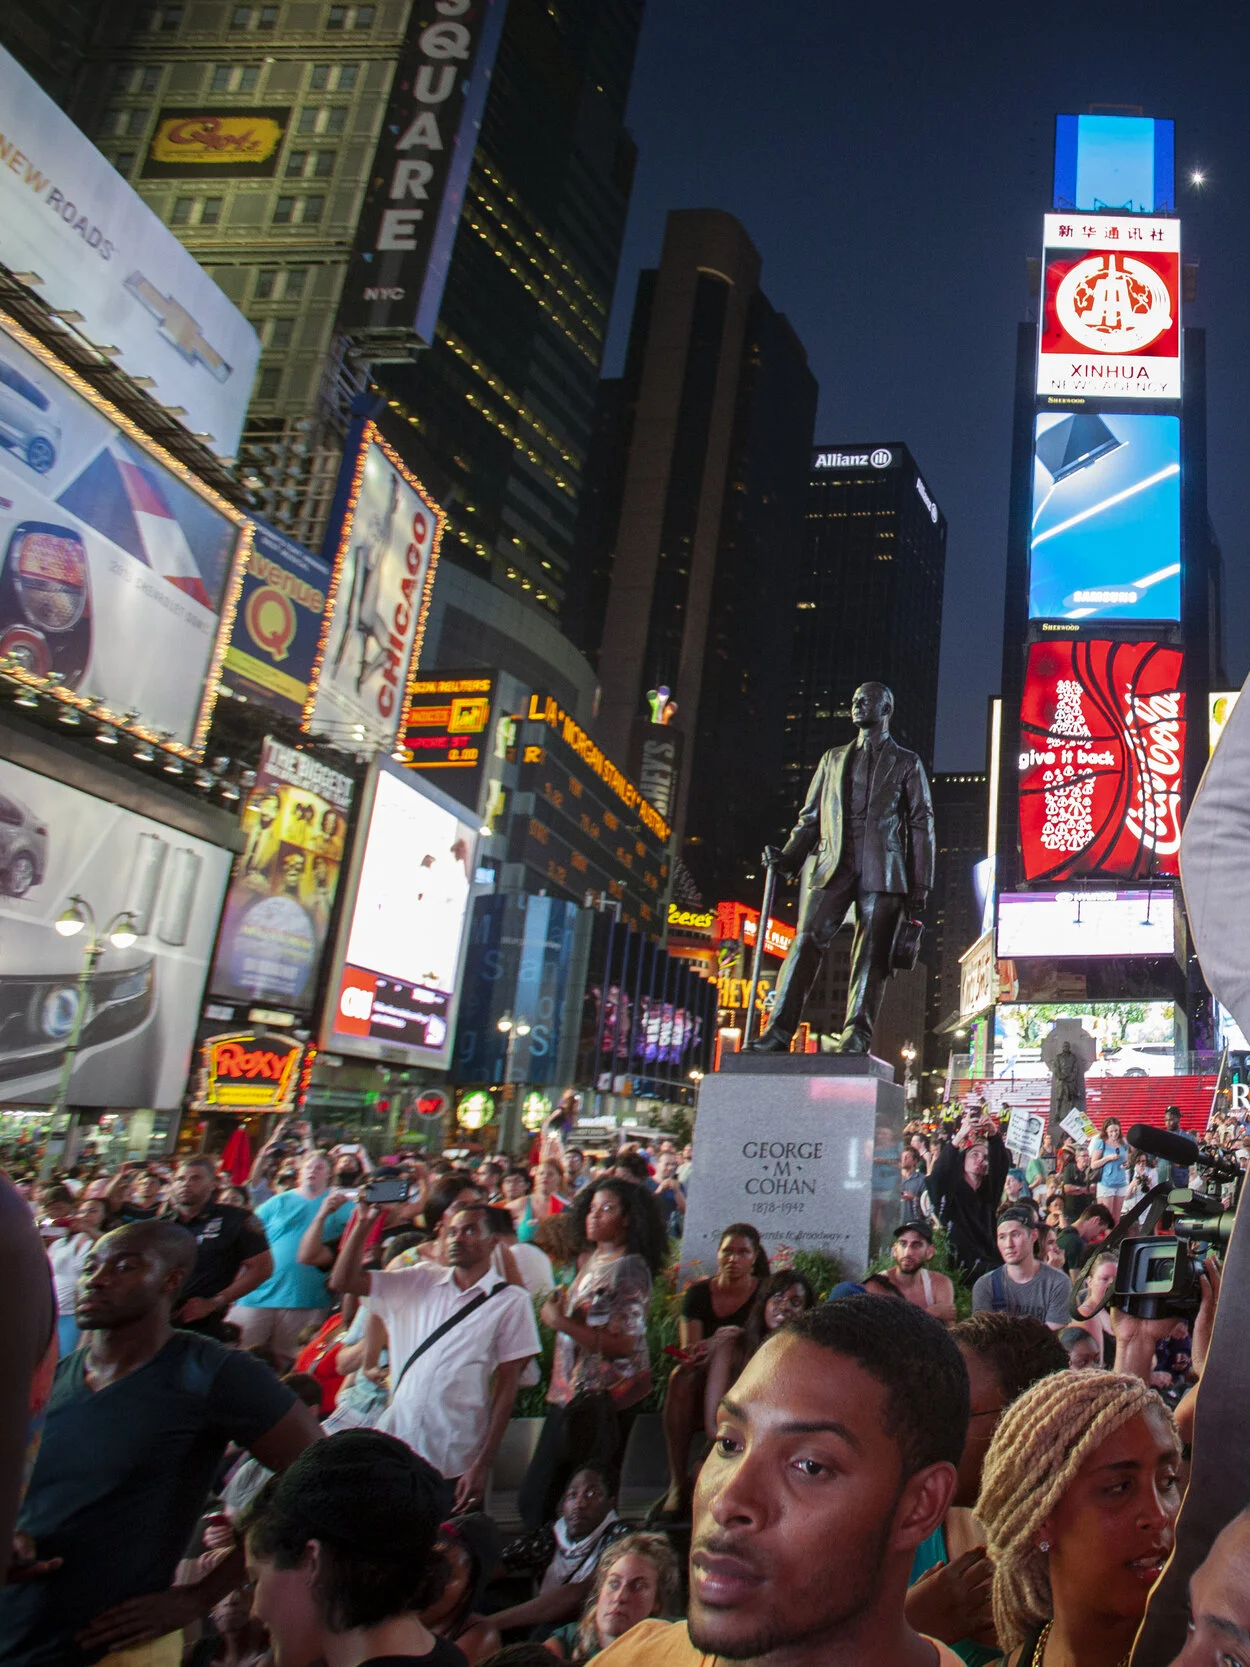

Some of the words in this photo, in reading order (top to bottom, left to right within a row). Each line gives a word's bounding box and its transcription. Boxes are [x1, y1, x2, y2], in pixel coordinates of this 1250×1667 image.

[45, 186, 116, 262] ROADS
[1058, 224, 1164, 241] 新华通讯社
[363, 287, 405, 301] NYC
[1071, 364, 1150, 380] XINHUA
[815, 453, 869, 468] Allianz
[377, 512, 428, 718] CHICAGO
[250, 586, 297, 662] Q
[1018, 748, 1056, 770] give
[1061, 748, 1074, 764] it
[1077, 750, 1115, 767] back
[742, 1141, 823, 1160] GEORGE
[773, 1161, 791, 1177] M
[745, 1179, 817, 1195] COHAN
[752, 1202, 806, 1214] 1878-1942
